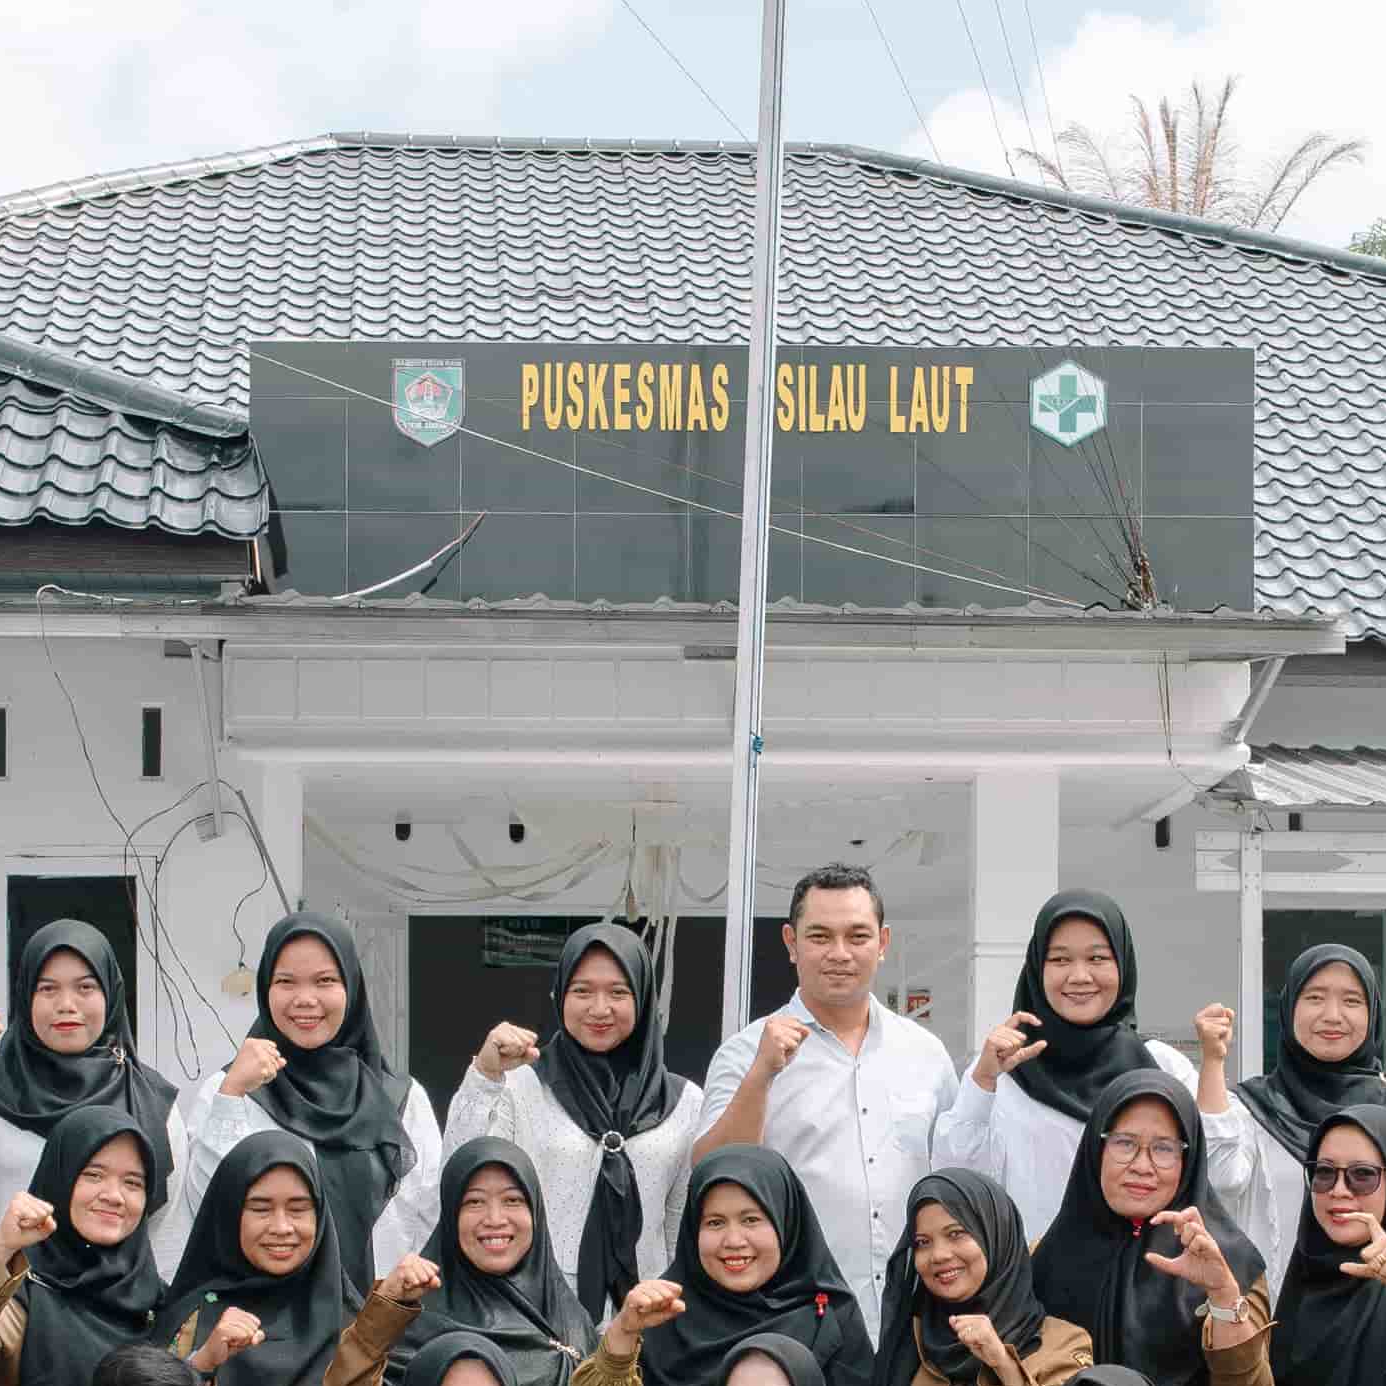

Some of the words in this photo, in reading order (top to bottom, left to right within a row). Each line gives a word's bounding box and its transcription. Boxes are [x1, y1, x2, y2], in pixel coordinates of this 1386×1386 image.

[521, 362, 729, 432] PUSKESMAS
[775, 363, 867, 433] SILAU
[889, 366, 974, 433] LAUT
